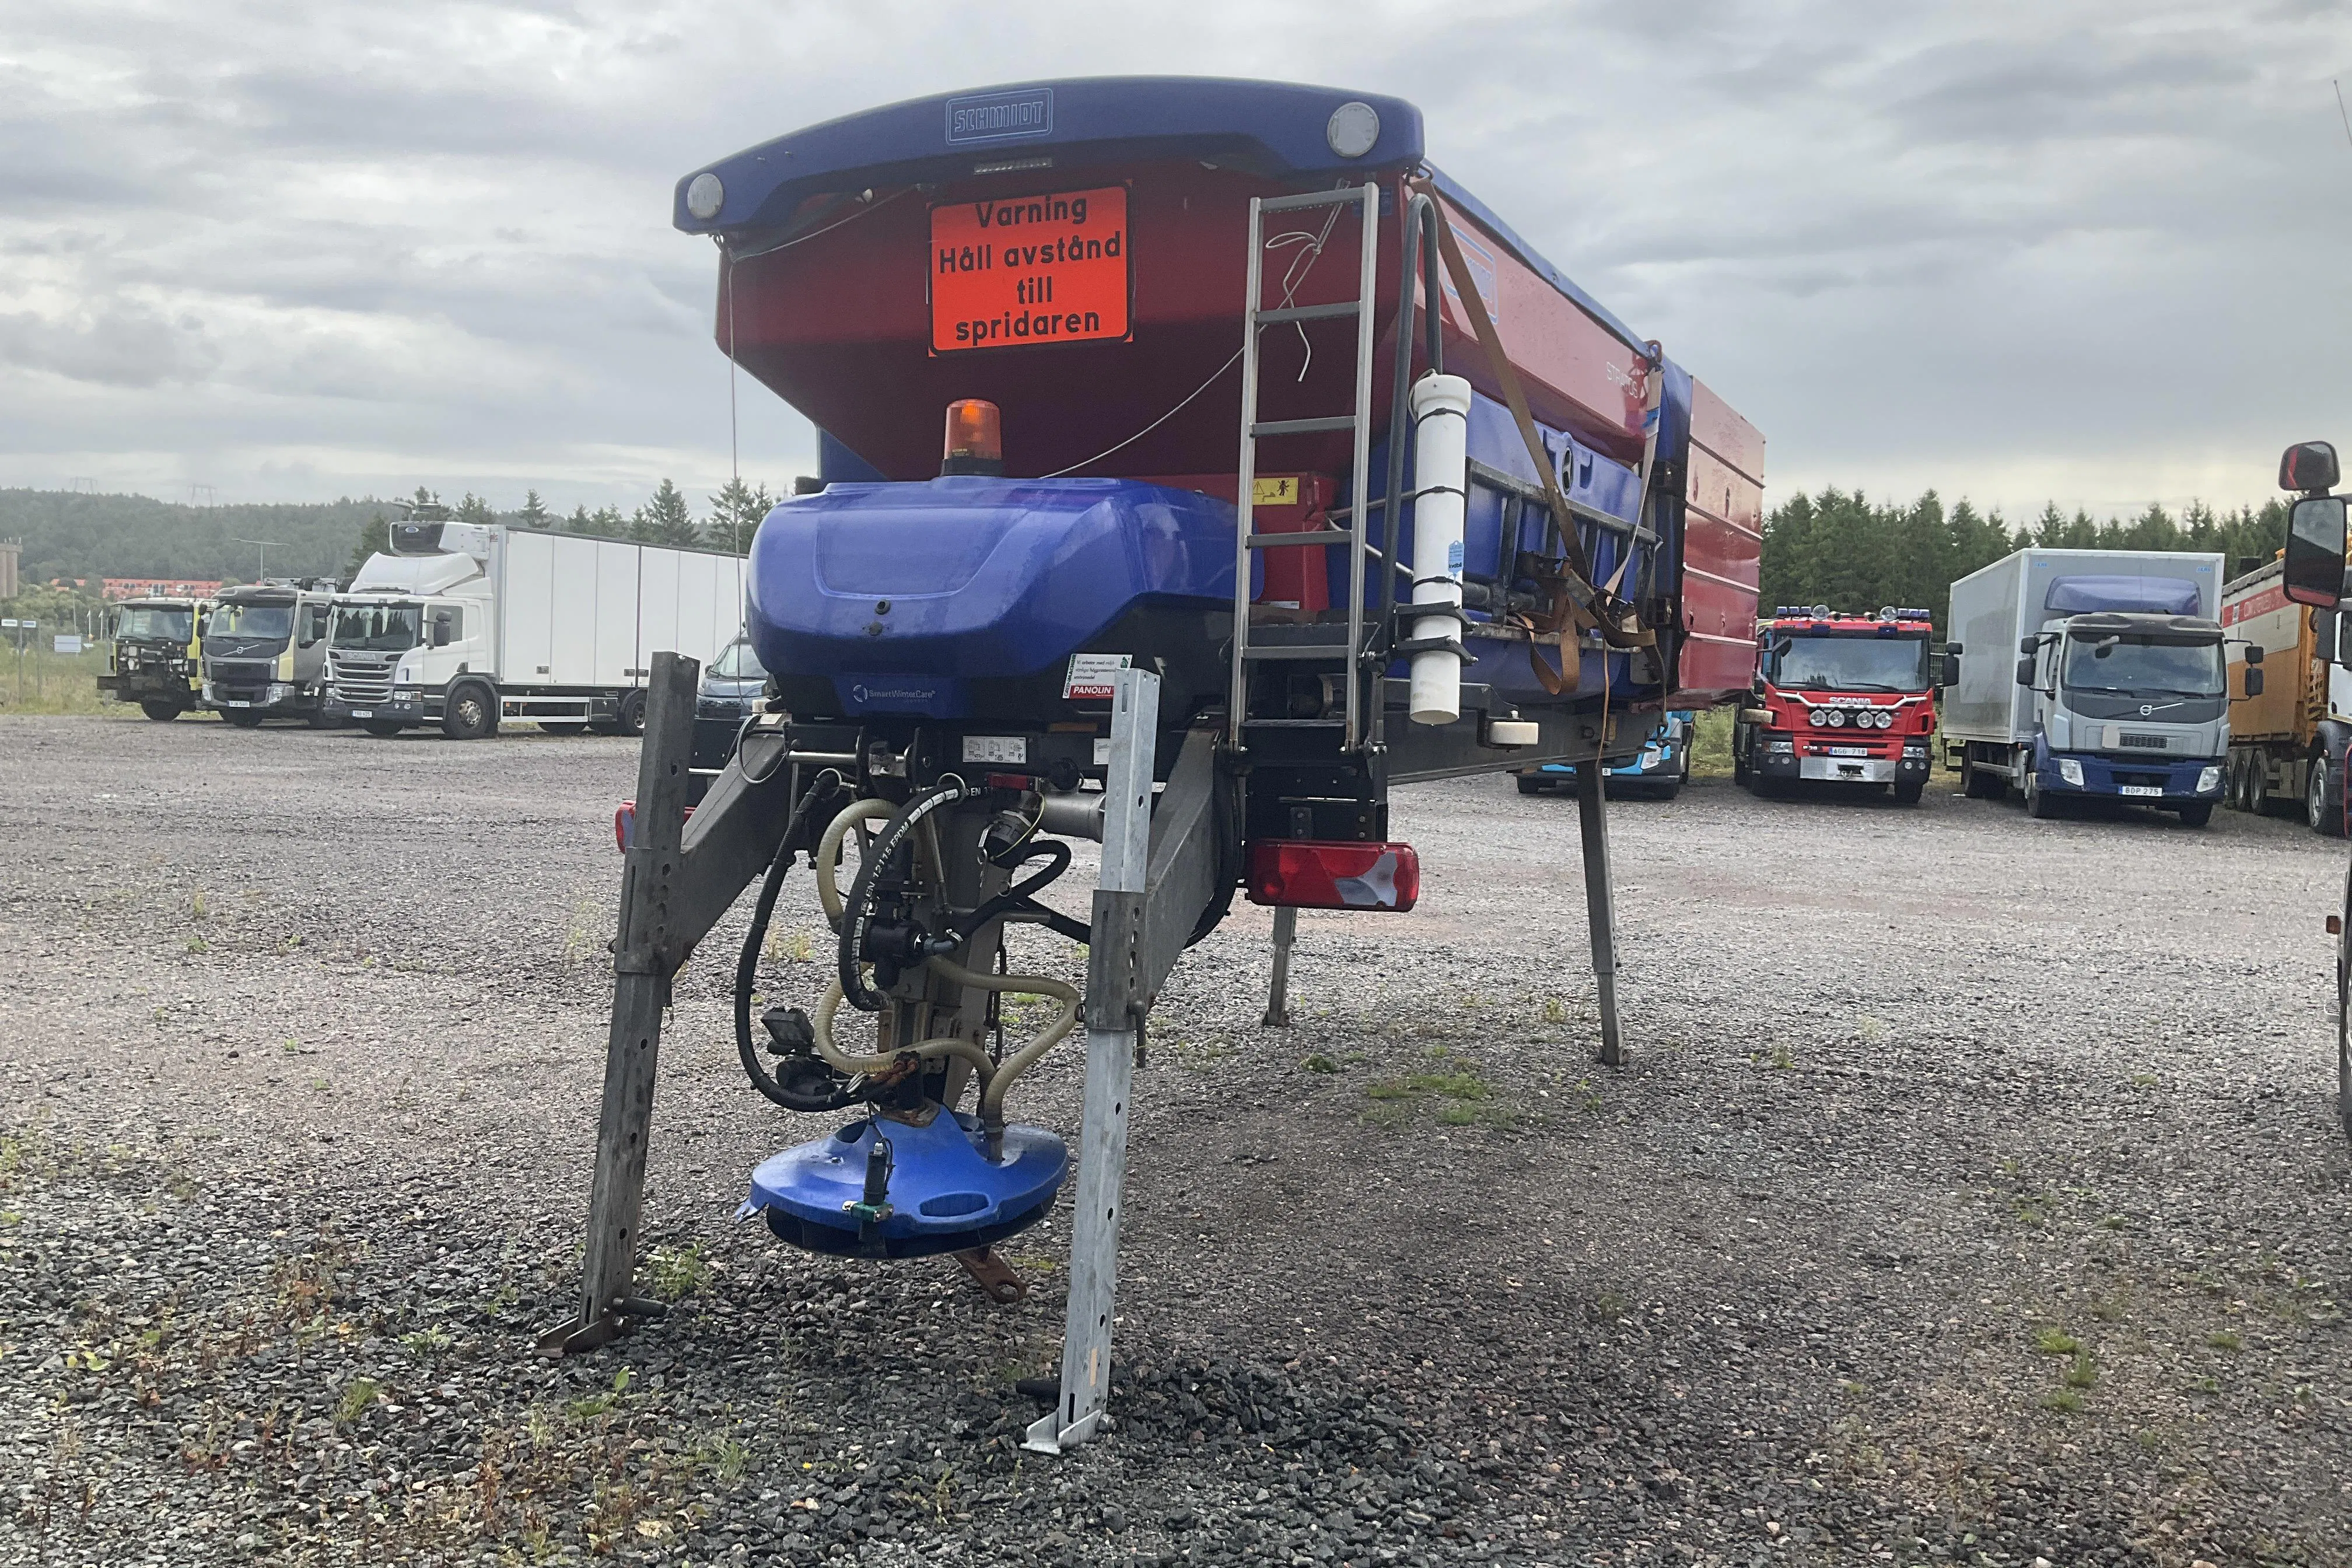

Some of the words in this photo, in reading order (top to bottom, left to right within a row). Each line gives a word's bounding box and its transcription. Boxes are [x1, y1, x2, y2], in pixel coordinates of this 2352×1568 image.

[954, 101, 1044, 132] SCHMIDT
[975, 195, 1087, 228] Varning
[939, 244, 992, 274] Håll
[1003, 230, 1121, 267] avstånd
[1017, 275, 1052, 304] till
[956, 310, 1100, 346] spridaren
[1073, 685, 1111, 694] PANOLIN
[1829, 696, 1872, 705] SCANIA
[970, 786, 981, 796] EN
[866, 881, 876, 898] EN
[890, 821, 910, 848] EPDM
